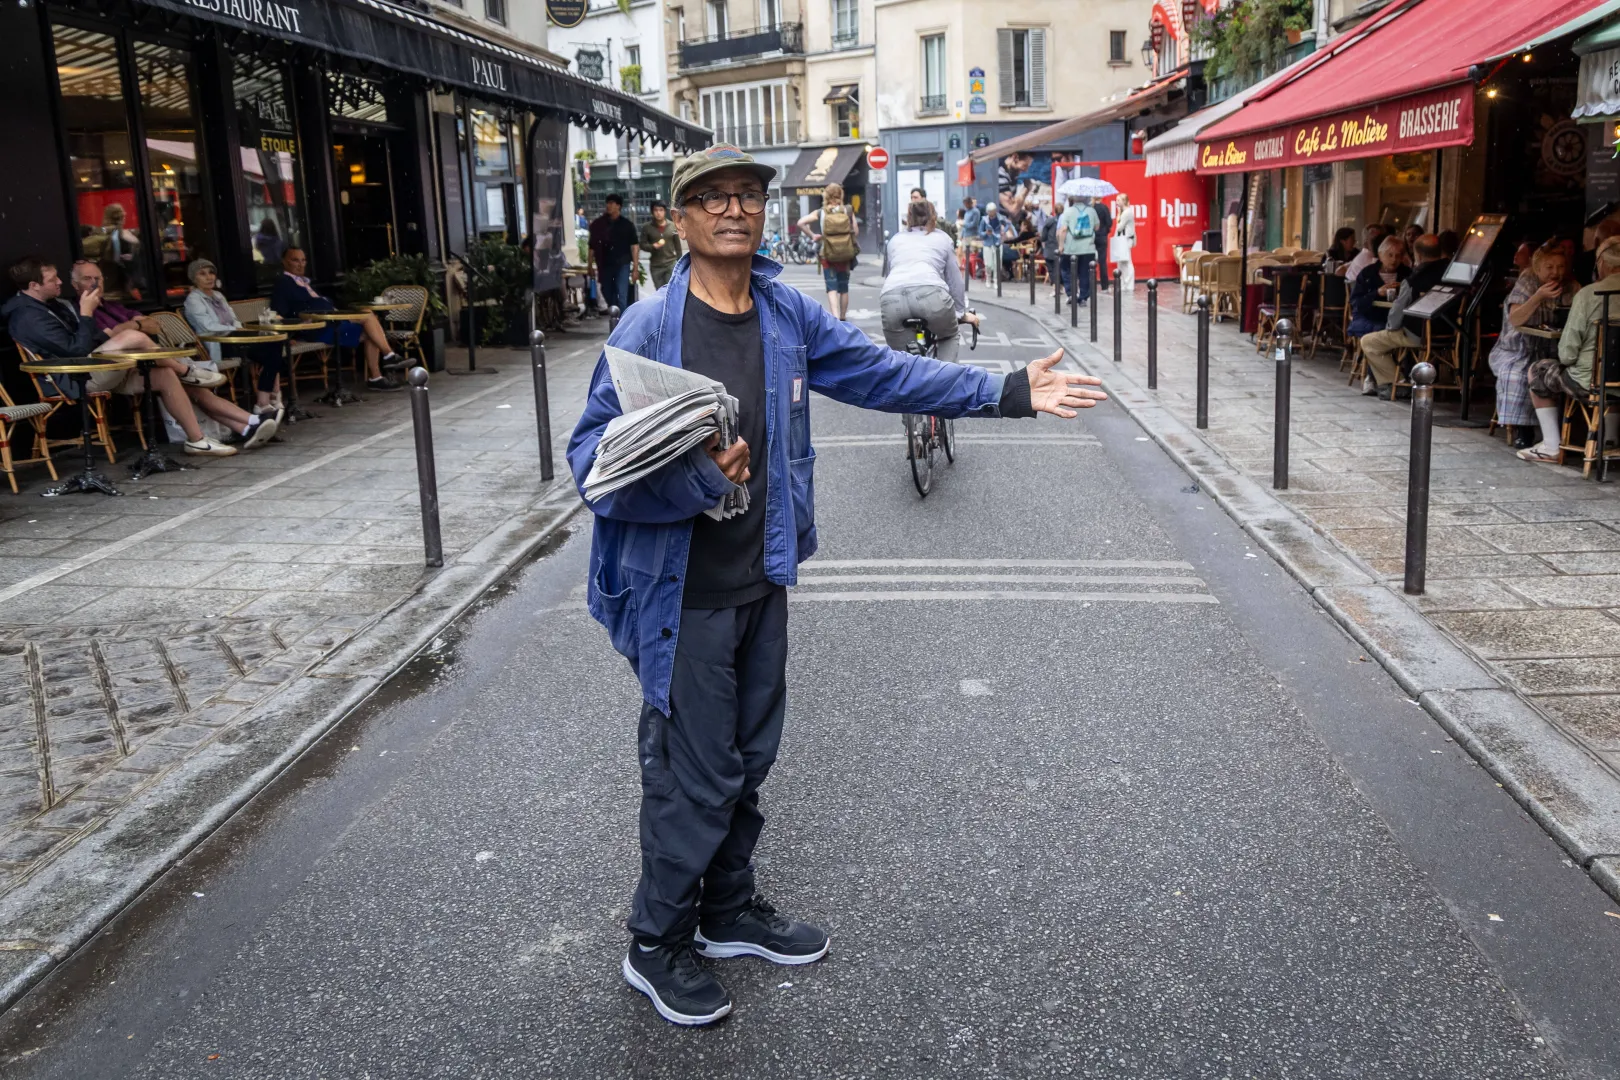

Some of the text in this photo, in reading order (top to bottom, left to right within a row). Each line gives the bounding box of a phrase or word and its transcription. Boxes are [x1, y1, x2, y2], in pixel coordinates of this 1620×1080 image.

[184, 0, 301, 33] TAURANT
[471, 56, 507, 91] PAUL
[260, 133, 296, 154] ÉTOILE
[1254, 136, 1284, 160] COCKTAILS
[1295, 126, 1321, 157] Café
[1320, 123, 1337, 151] Le
[1341, 115, 1388, 148] Molière
[1400, 98, 1461, 138] BRASSERIE
